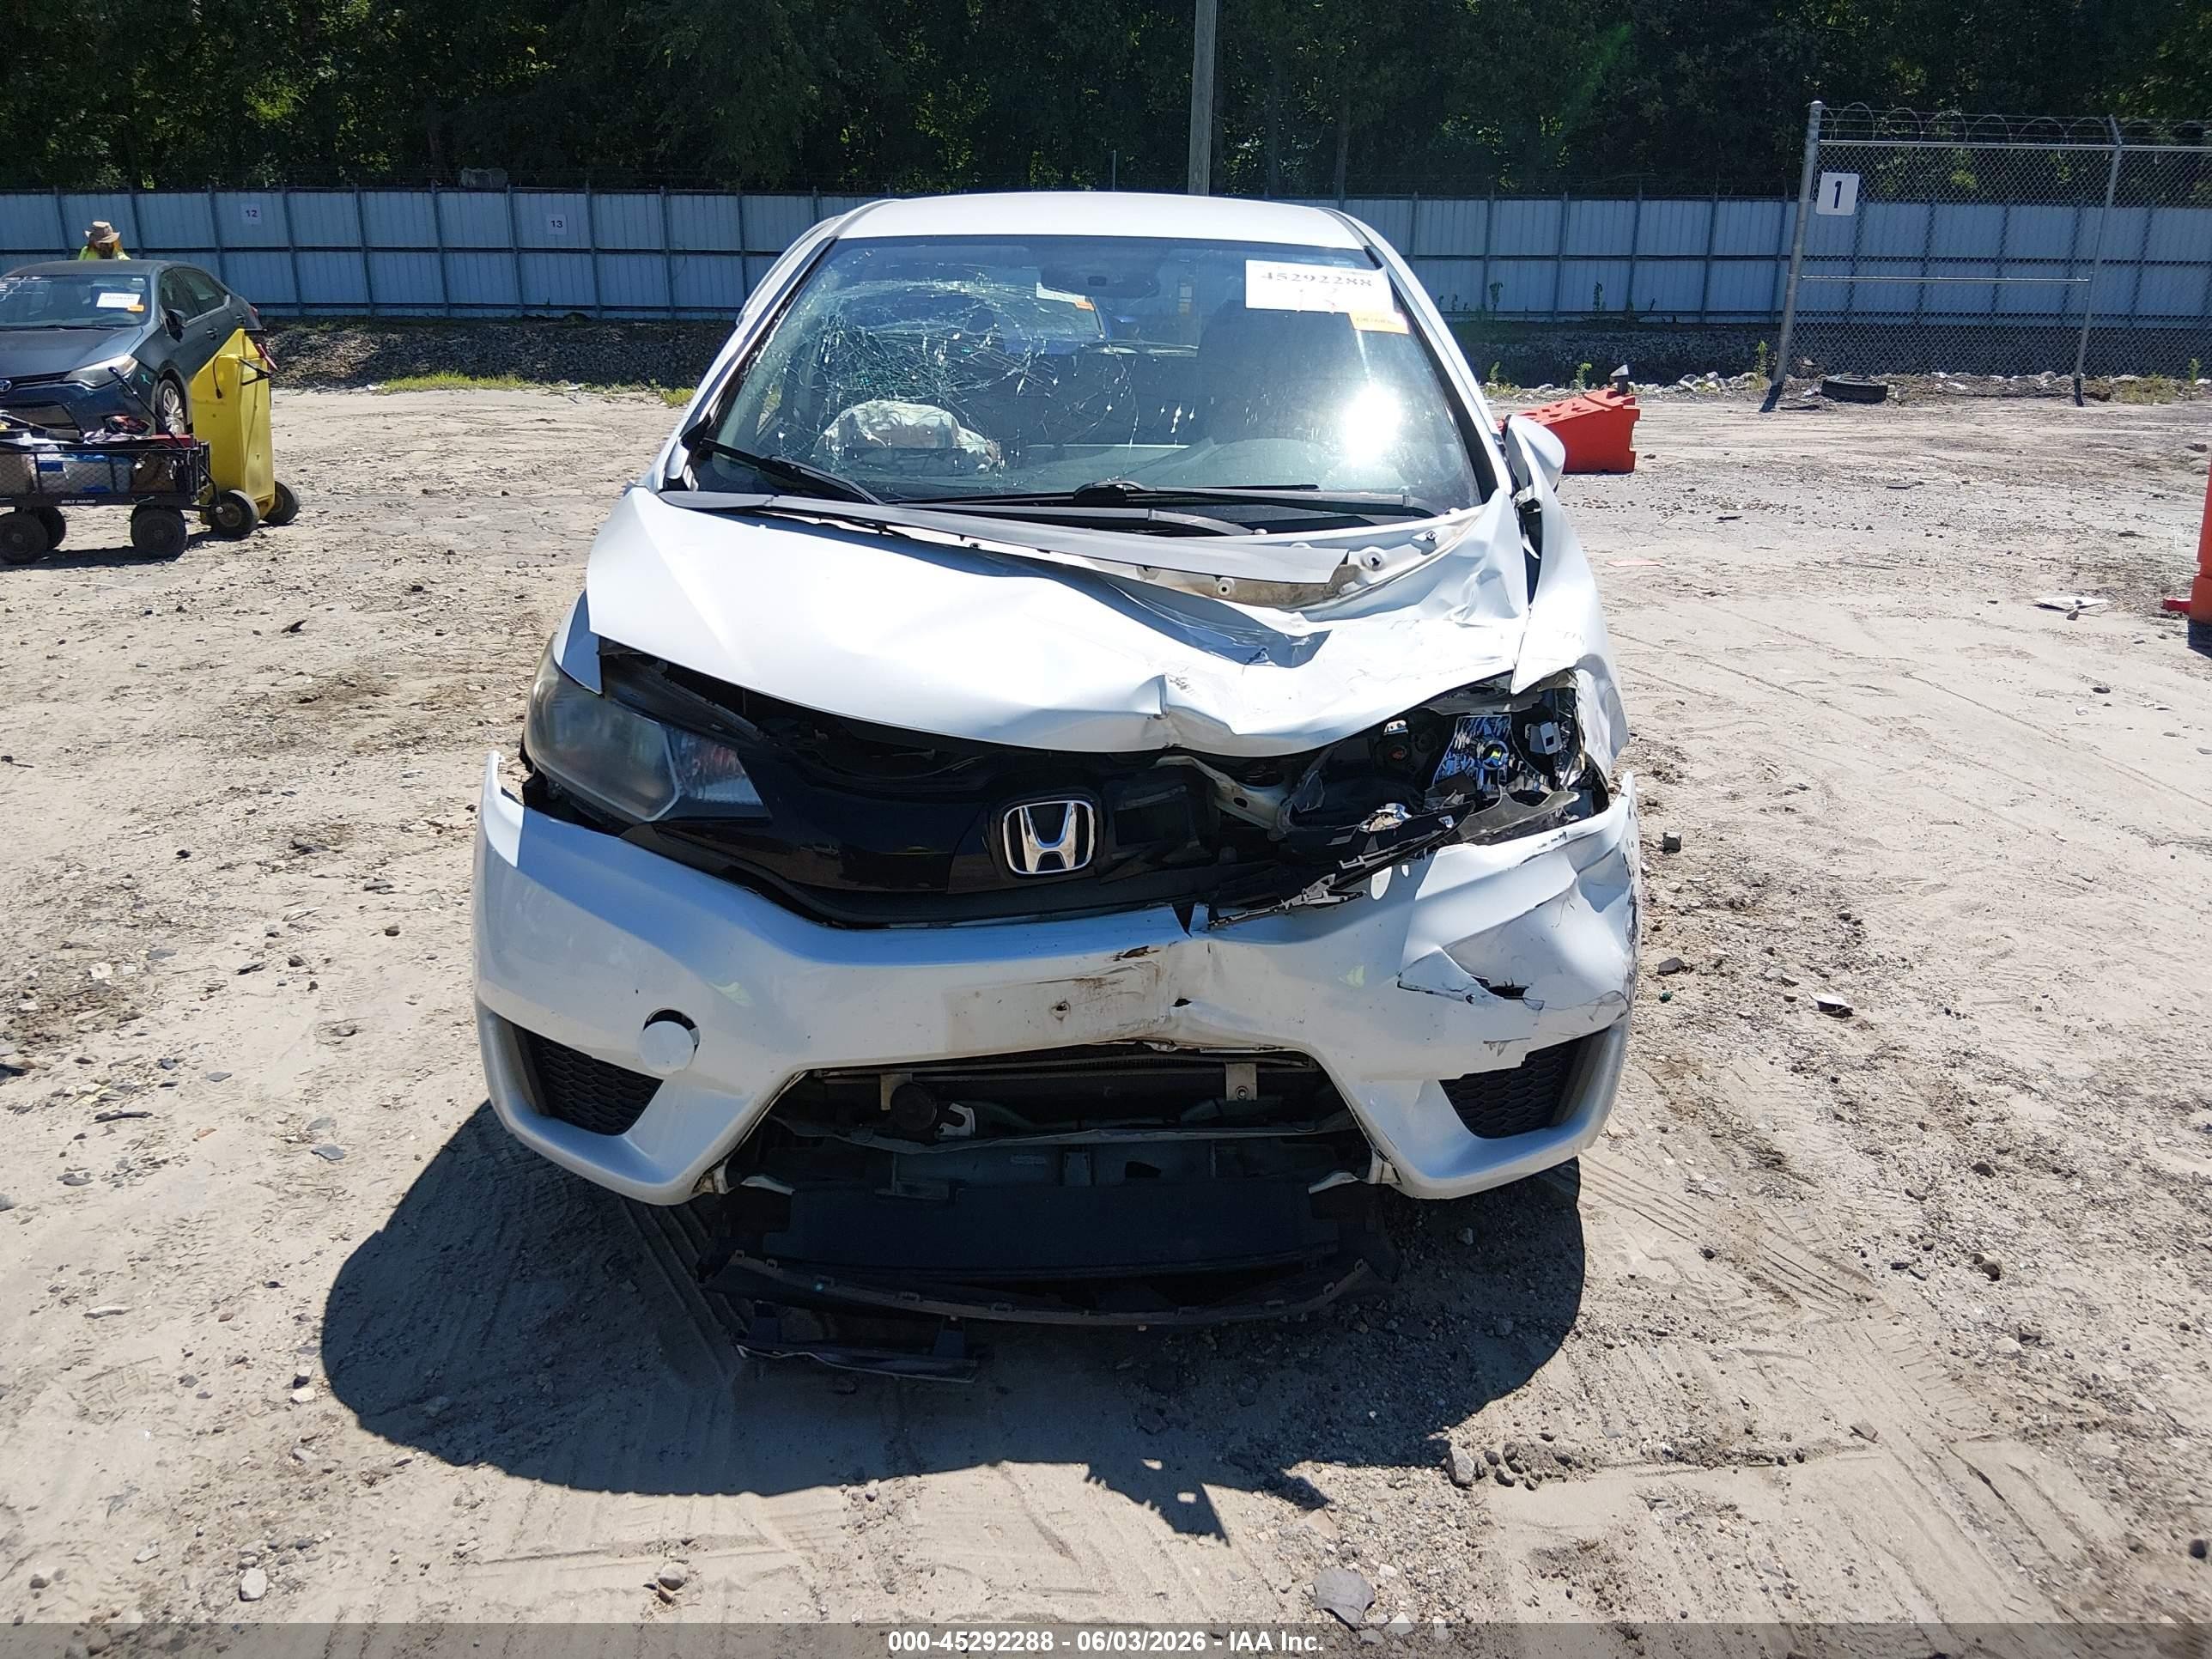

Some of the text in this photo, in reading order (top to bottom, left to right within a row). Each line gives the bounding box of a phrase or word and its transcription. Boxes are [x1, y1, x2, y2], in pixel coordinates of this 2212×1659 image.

[1834, 180, 1842, 209] 1
[550, 220, 563, 228] 13
[1261, 272, 1372, 287] 45292288
